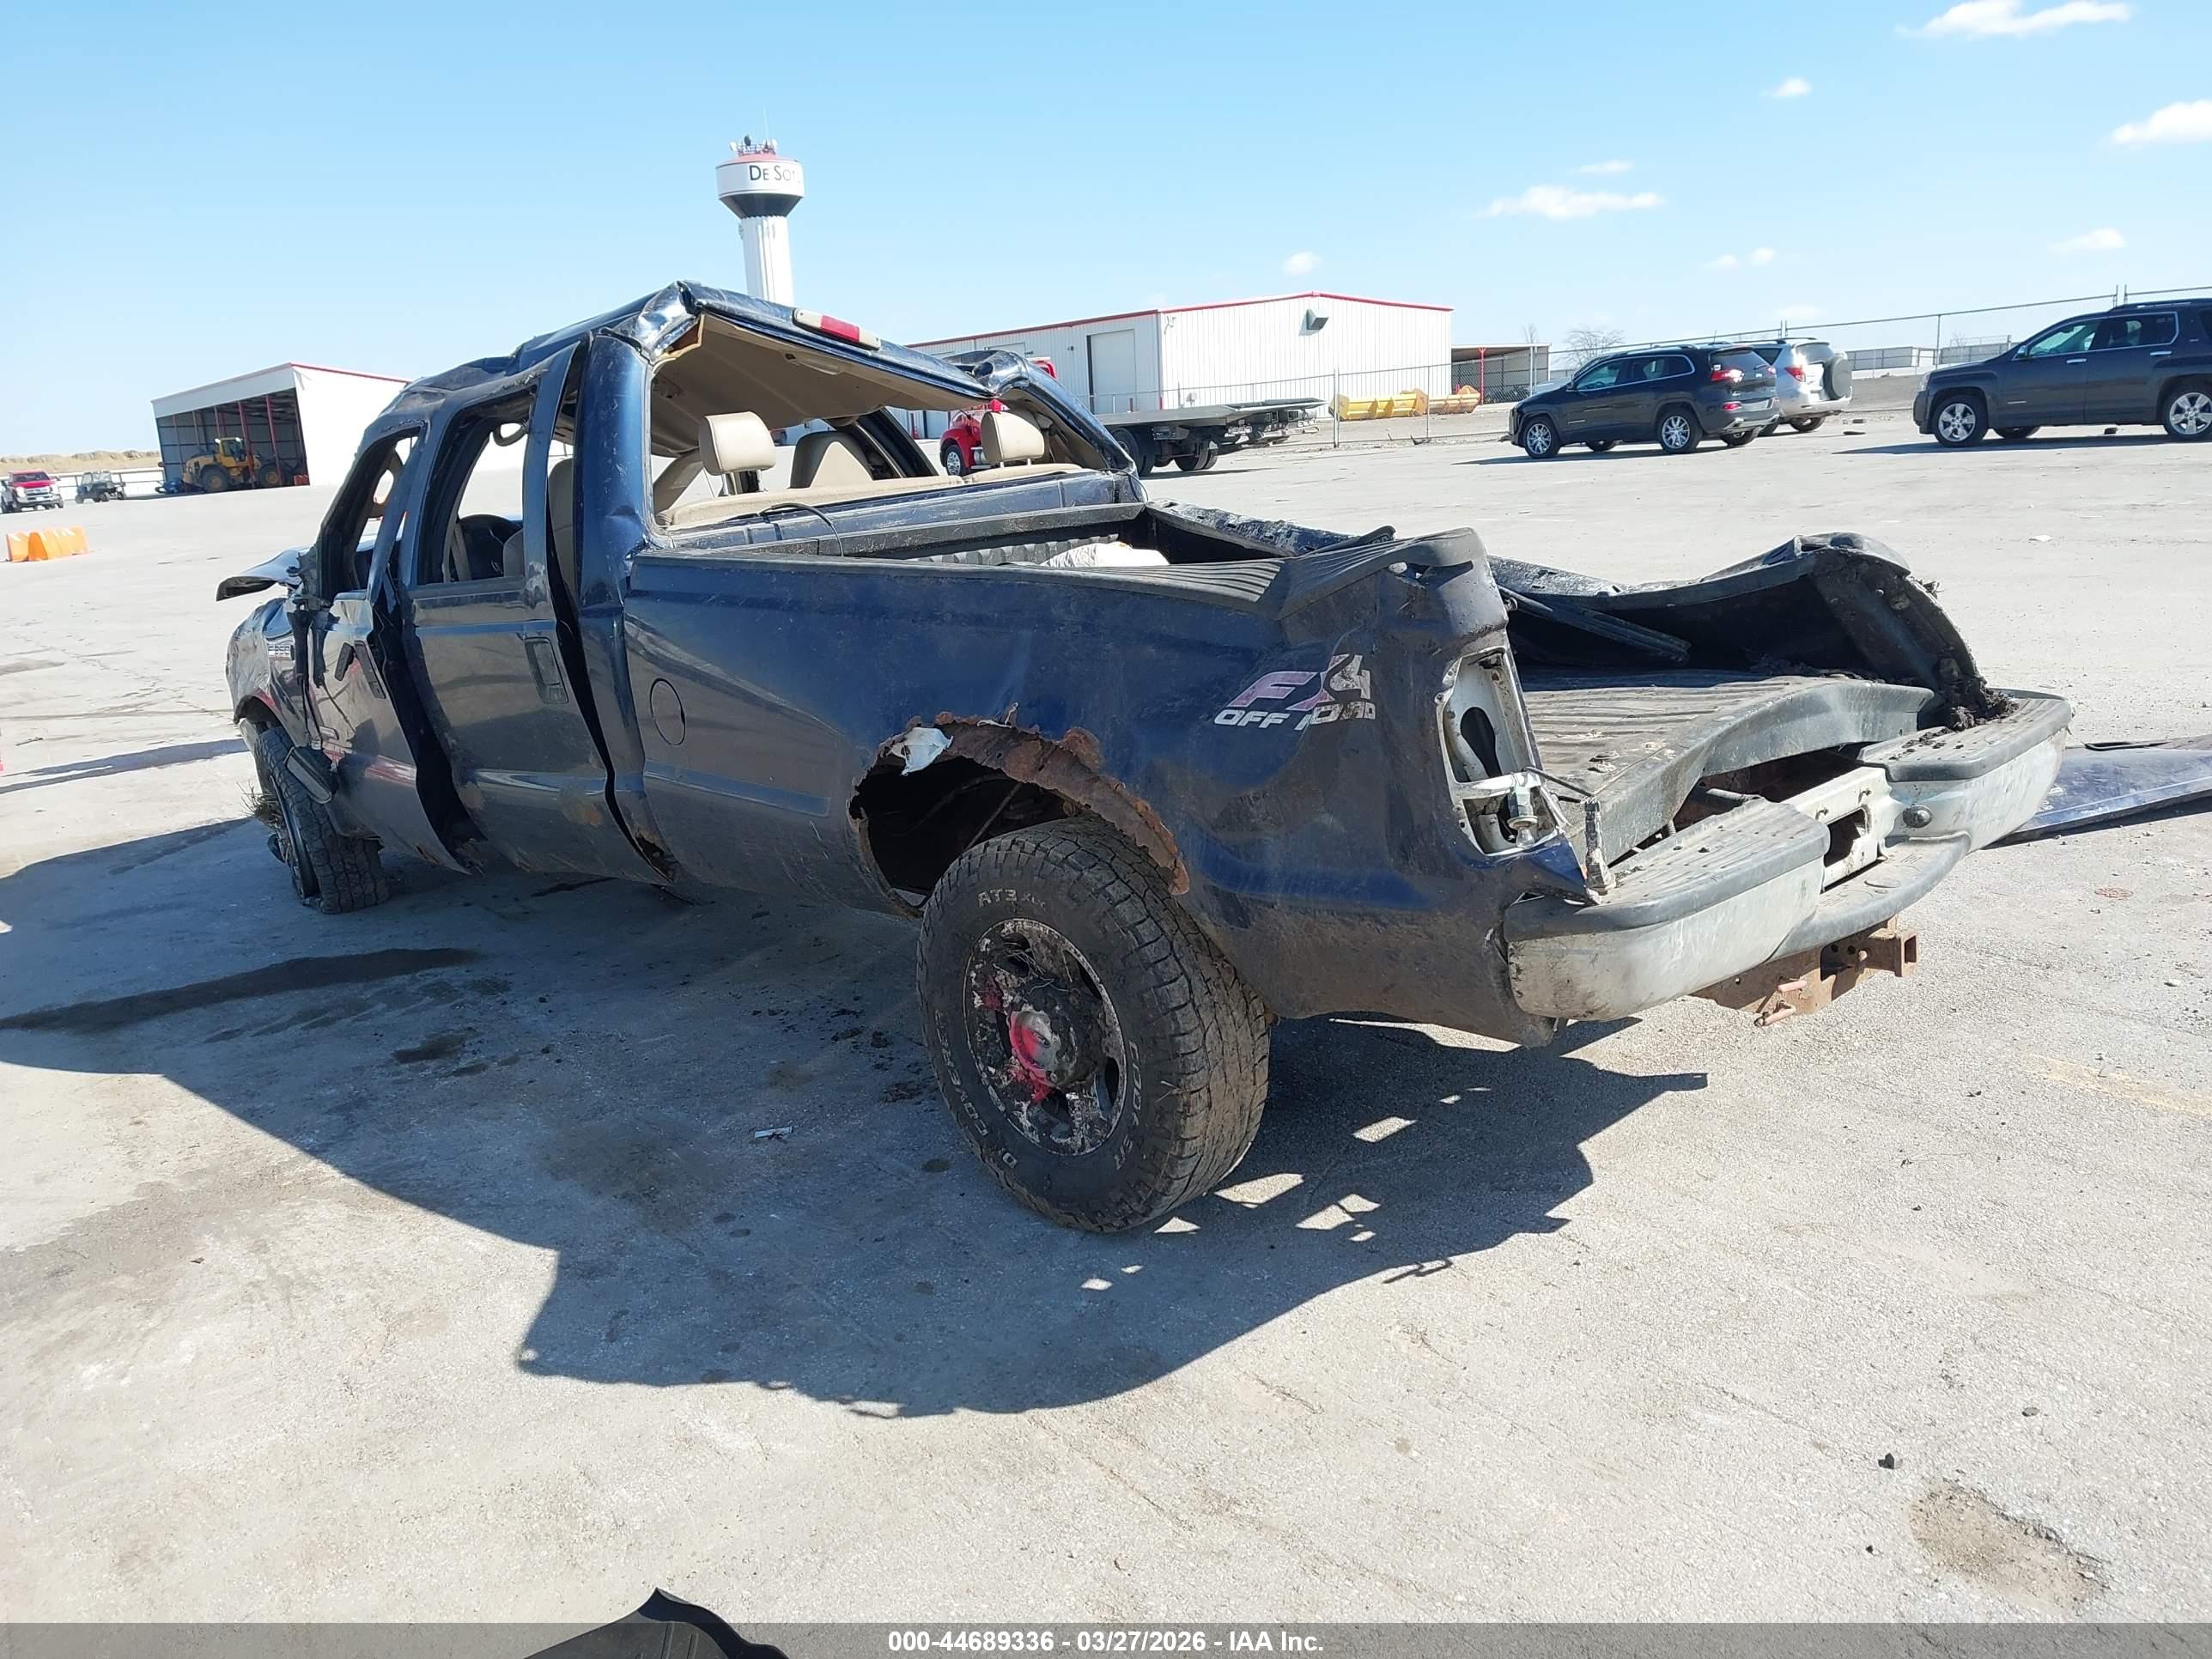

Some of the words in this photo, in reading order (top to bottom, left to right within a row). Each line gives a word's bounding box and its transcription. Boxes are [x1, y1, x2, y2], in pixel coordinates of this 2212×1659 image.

[774, 165, 796, 182] SOT
[1226, 653, 1371, 711] FX4
[1214, 709, 1290, 729] OFF
[978, 888, 1018, 908] AT3
